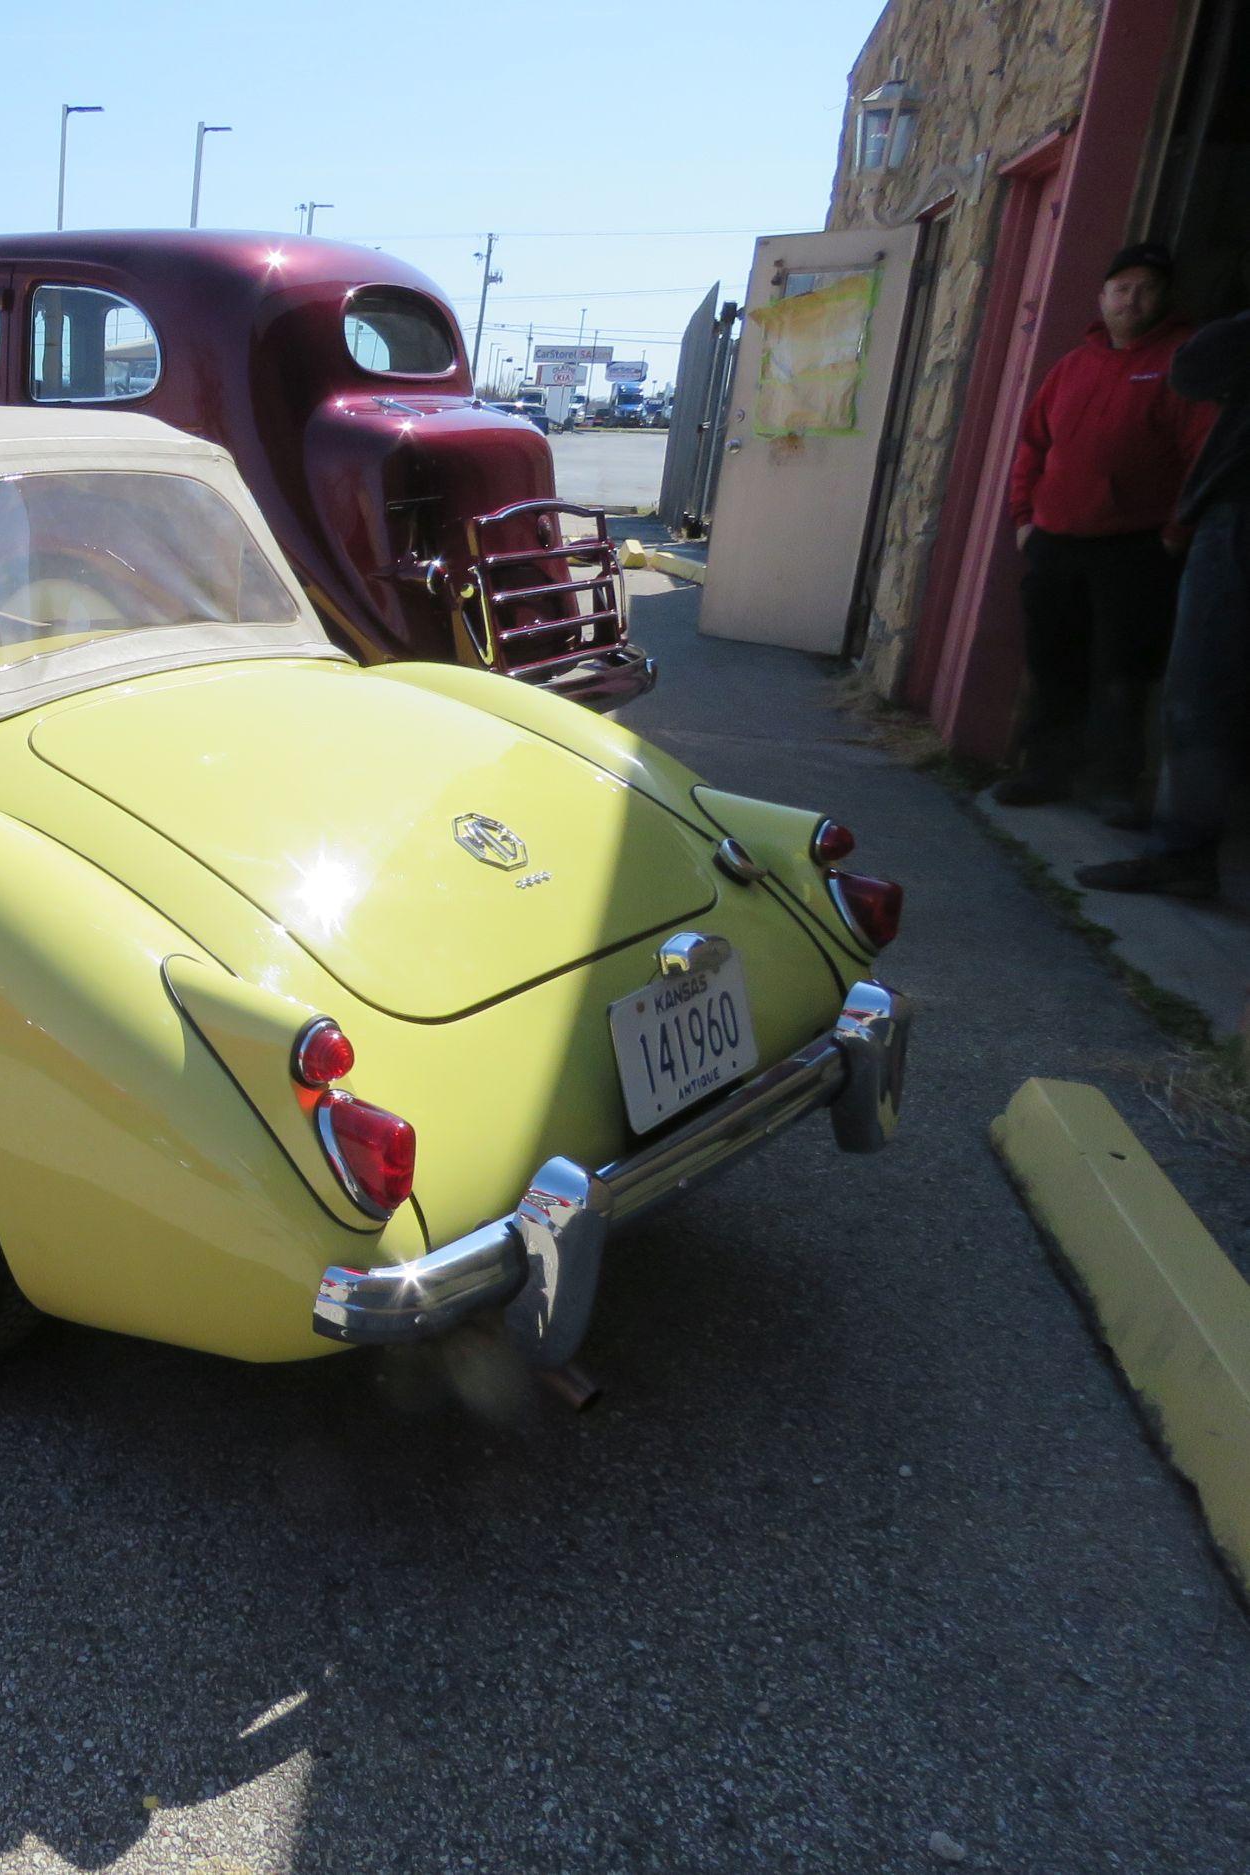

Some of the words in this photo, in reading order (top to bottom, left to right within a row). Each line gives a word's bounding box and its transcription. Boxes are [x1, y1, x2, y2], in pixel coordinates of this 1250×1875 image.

[654, 973, 708, 1016] KANSAS
[639, 991, 740, 1095] 141960
[678, 1066, 721, 1101] ANTIQUE
